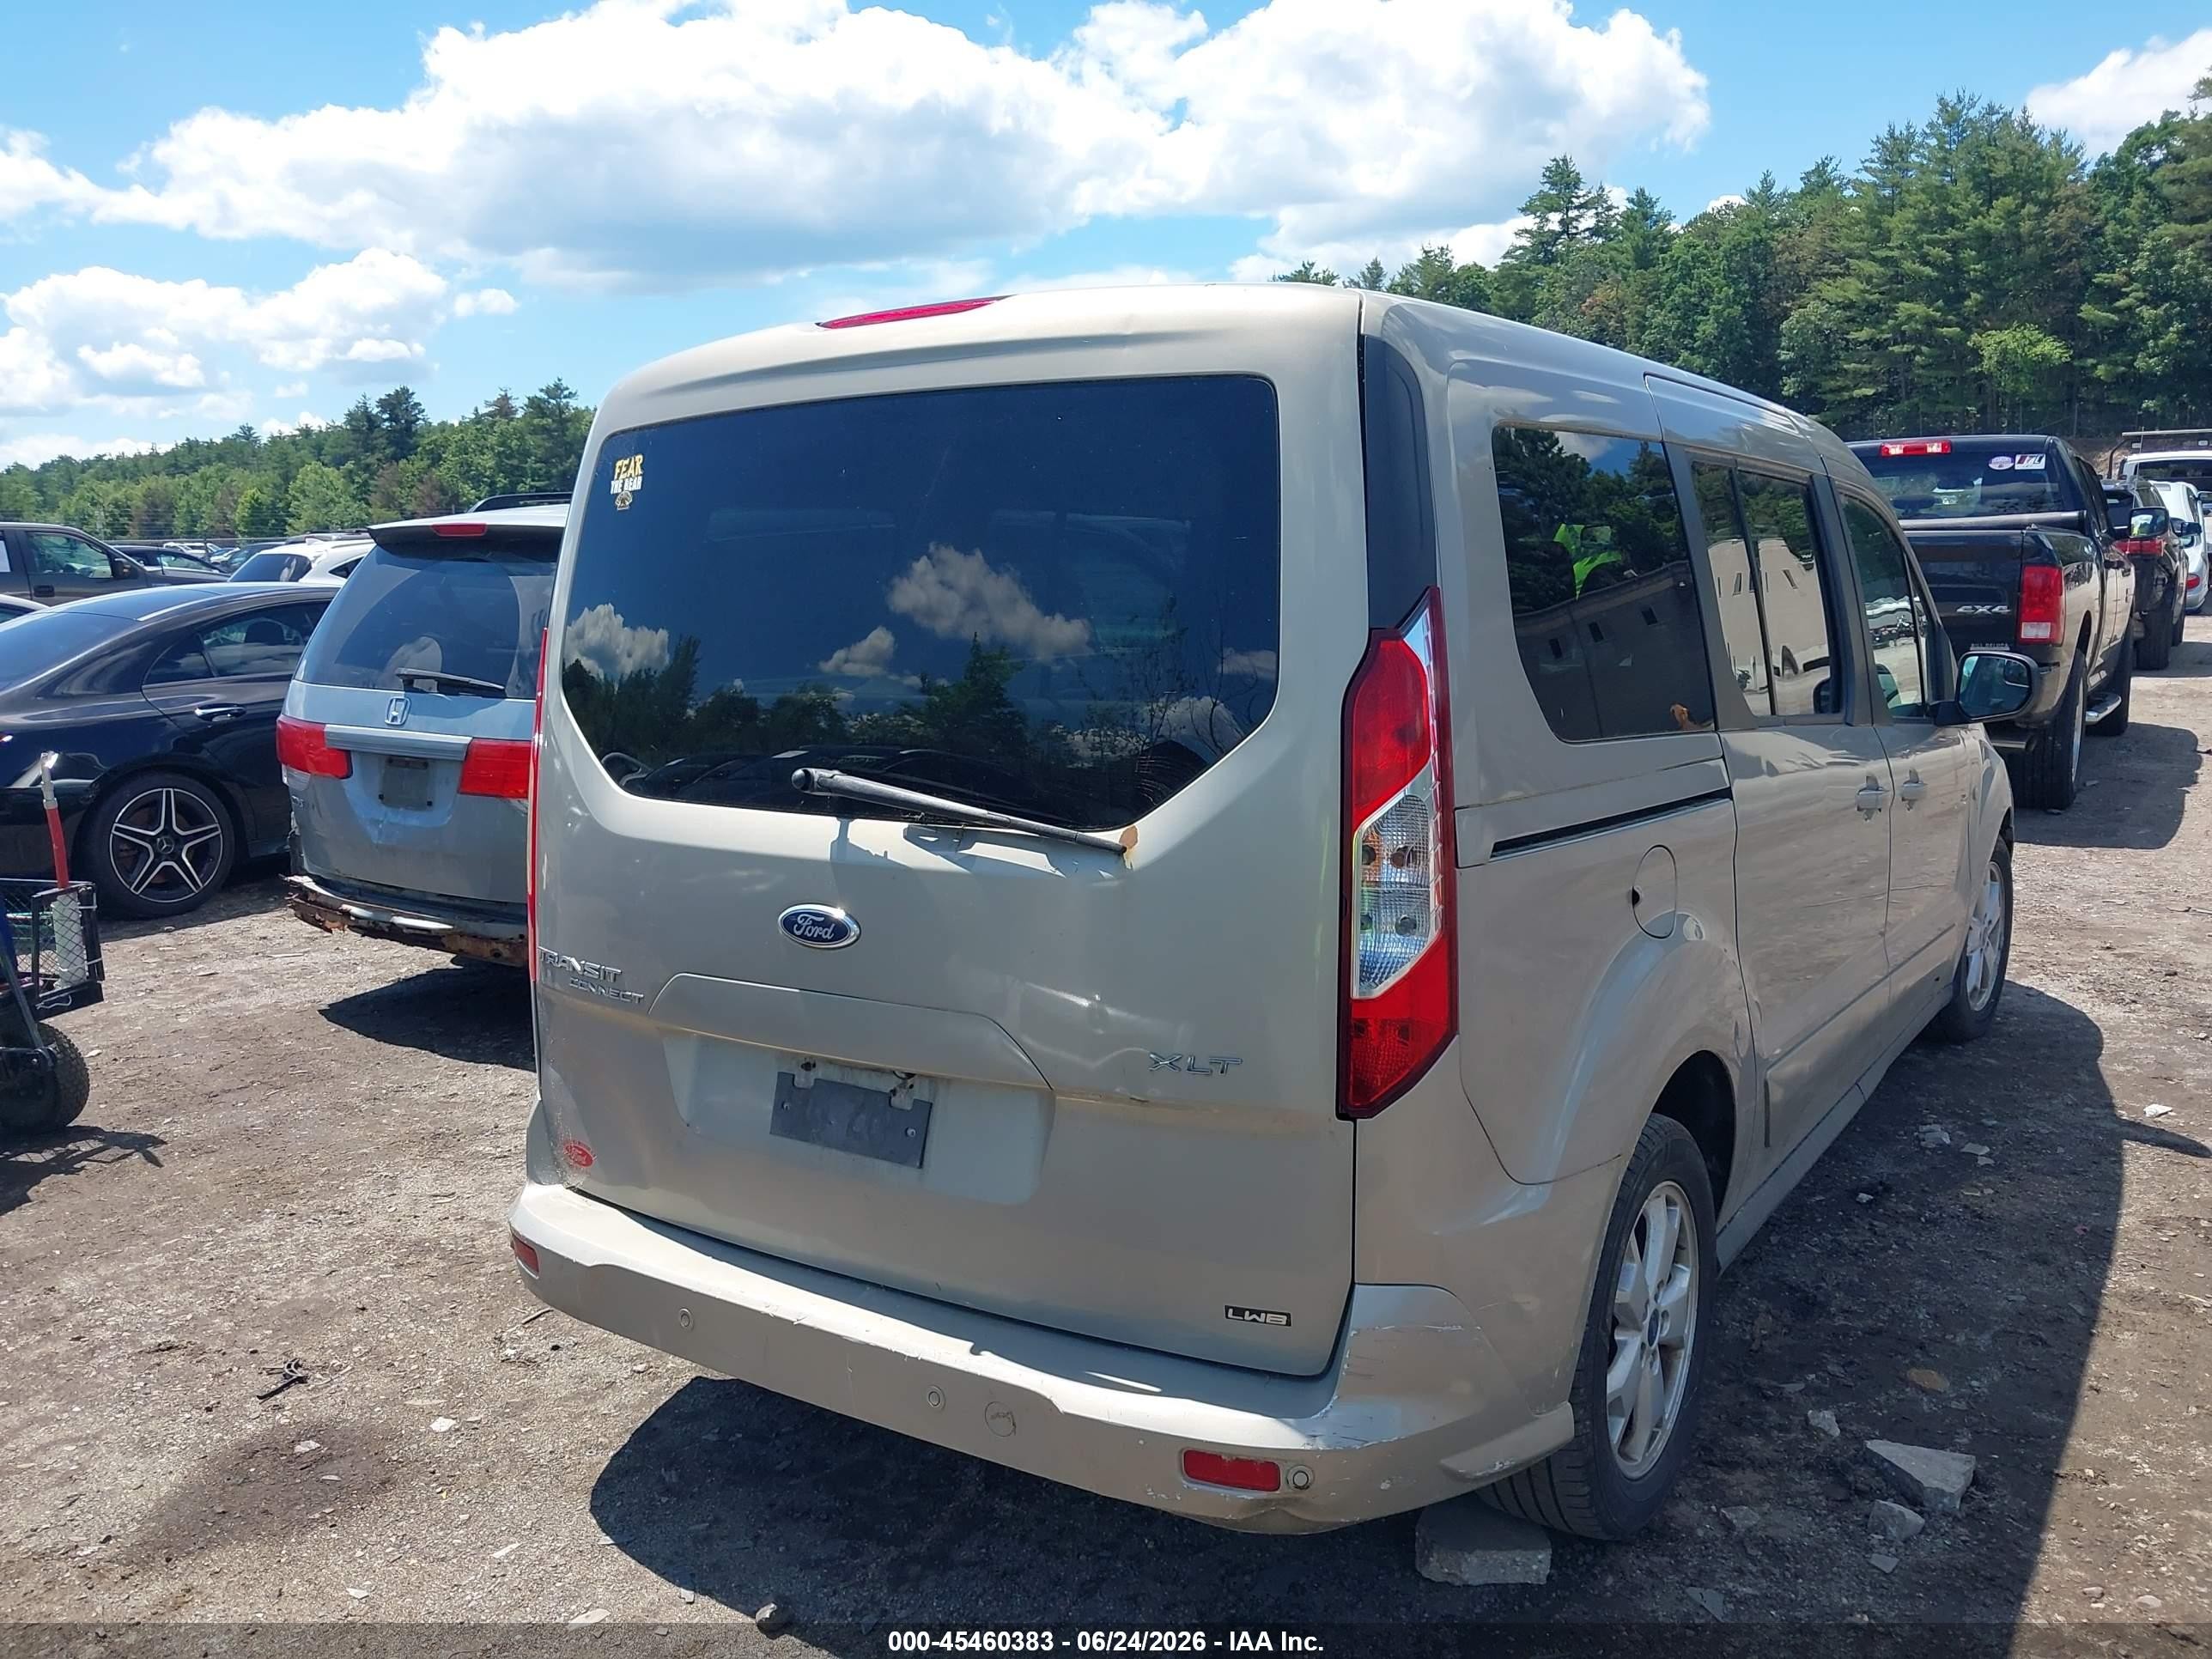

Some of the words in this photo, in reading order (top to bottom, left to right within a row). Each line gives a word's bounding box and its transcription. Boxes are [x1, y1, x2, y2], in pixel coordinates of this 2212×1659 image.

[614, 453, 644, 481] FEAR
[611, 480, 623, 495] THE
[793, 913, 836, 940] Ford
[537, 945, 623, 983] TRANSIT
[568, 977, 645, 1004] CONNECT
[1148, 1053, 1243, 1076] XLT
[1227, 1308, 1287, 1325] LWB
